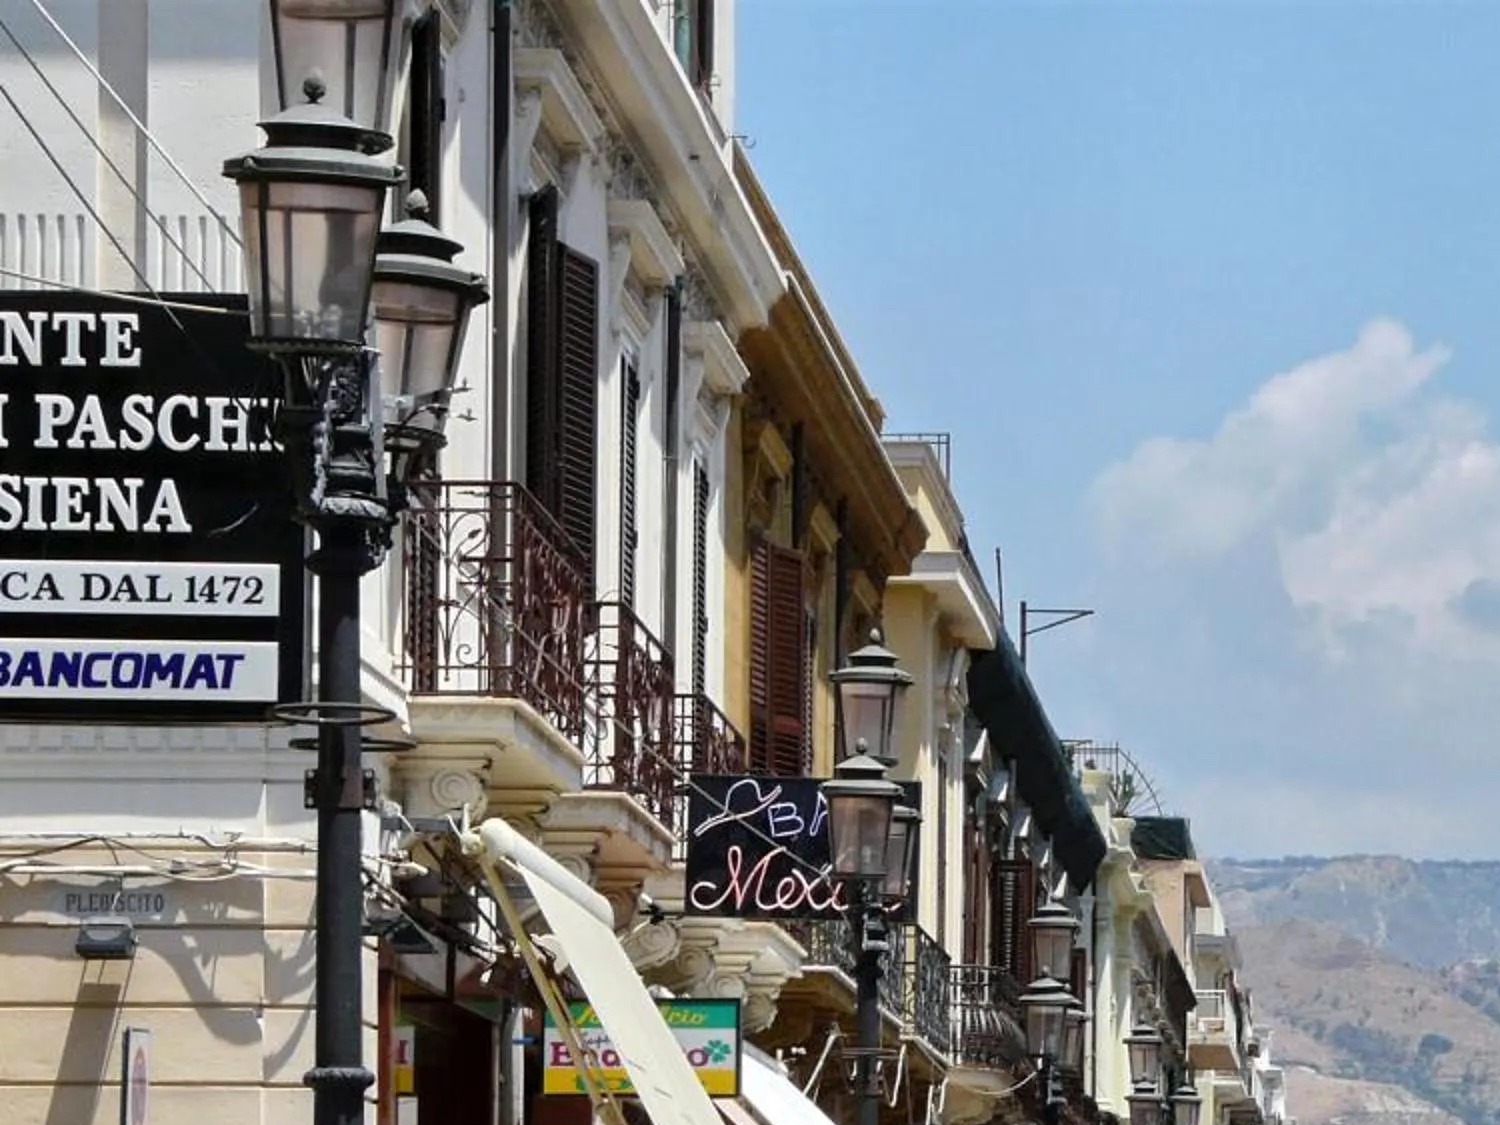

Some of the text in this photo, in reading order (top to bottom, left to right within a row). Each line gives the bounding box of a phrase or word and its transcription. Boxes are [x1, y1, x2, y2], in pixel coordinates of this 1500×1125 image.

[0, 312, 141, 367] NTE
[0, 476, 192, 533] SIENA
[1, 571, 264, 605] CA DAL 1472
